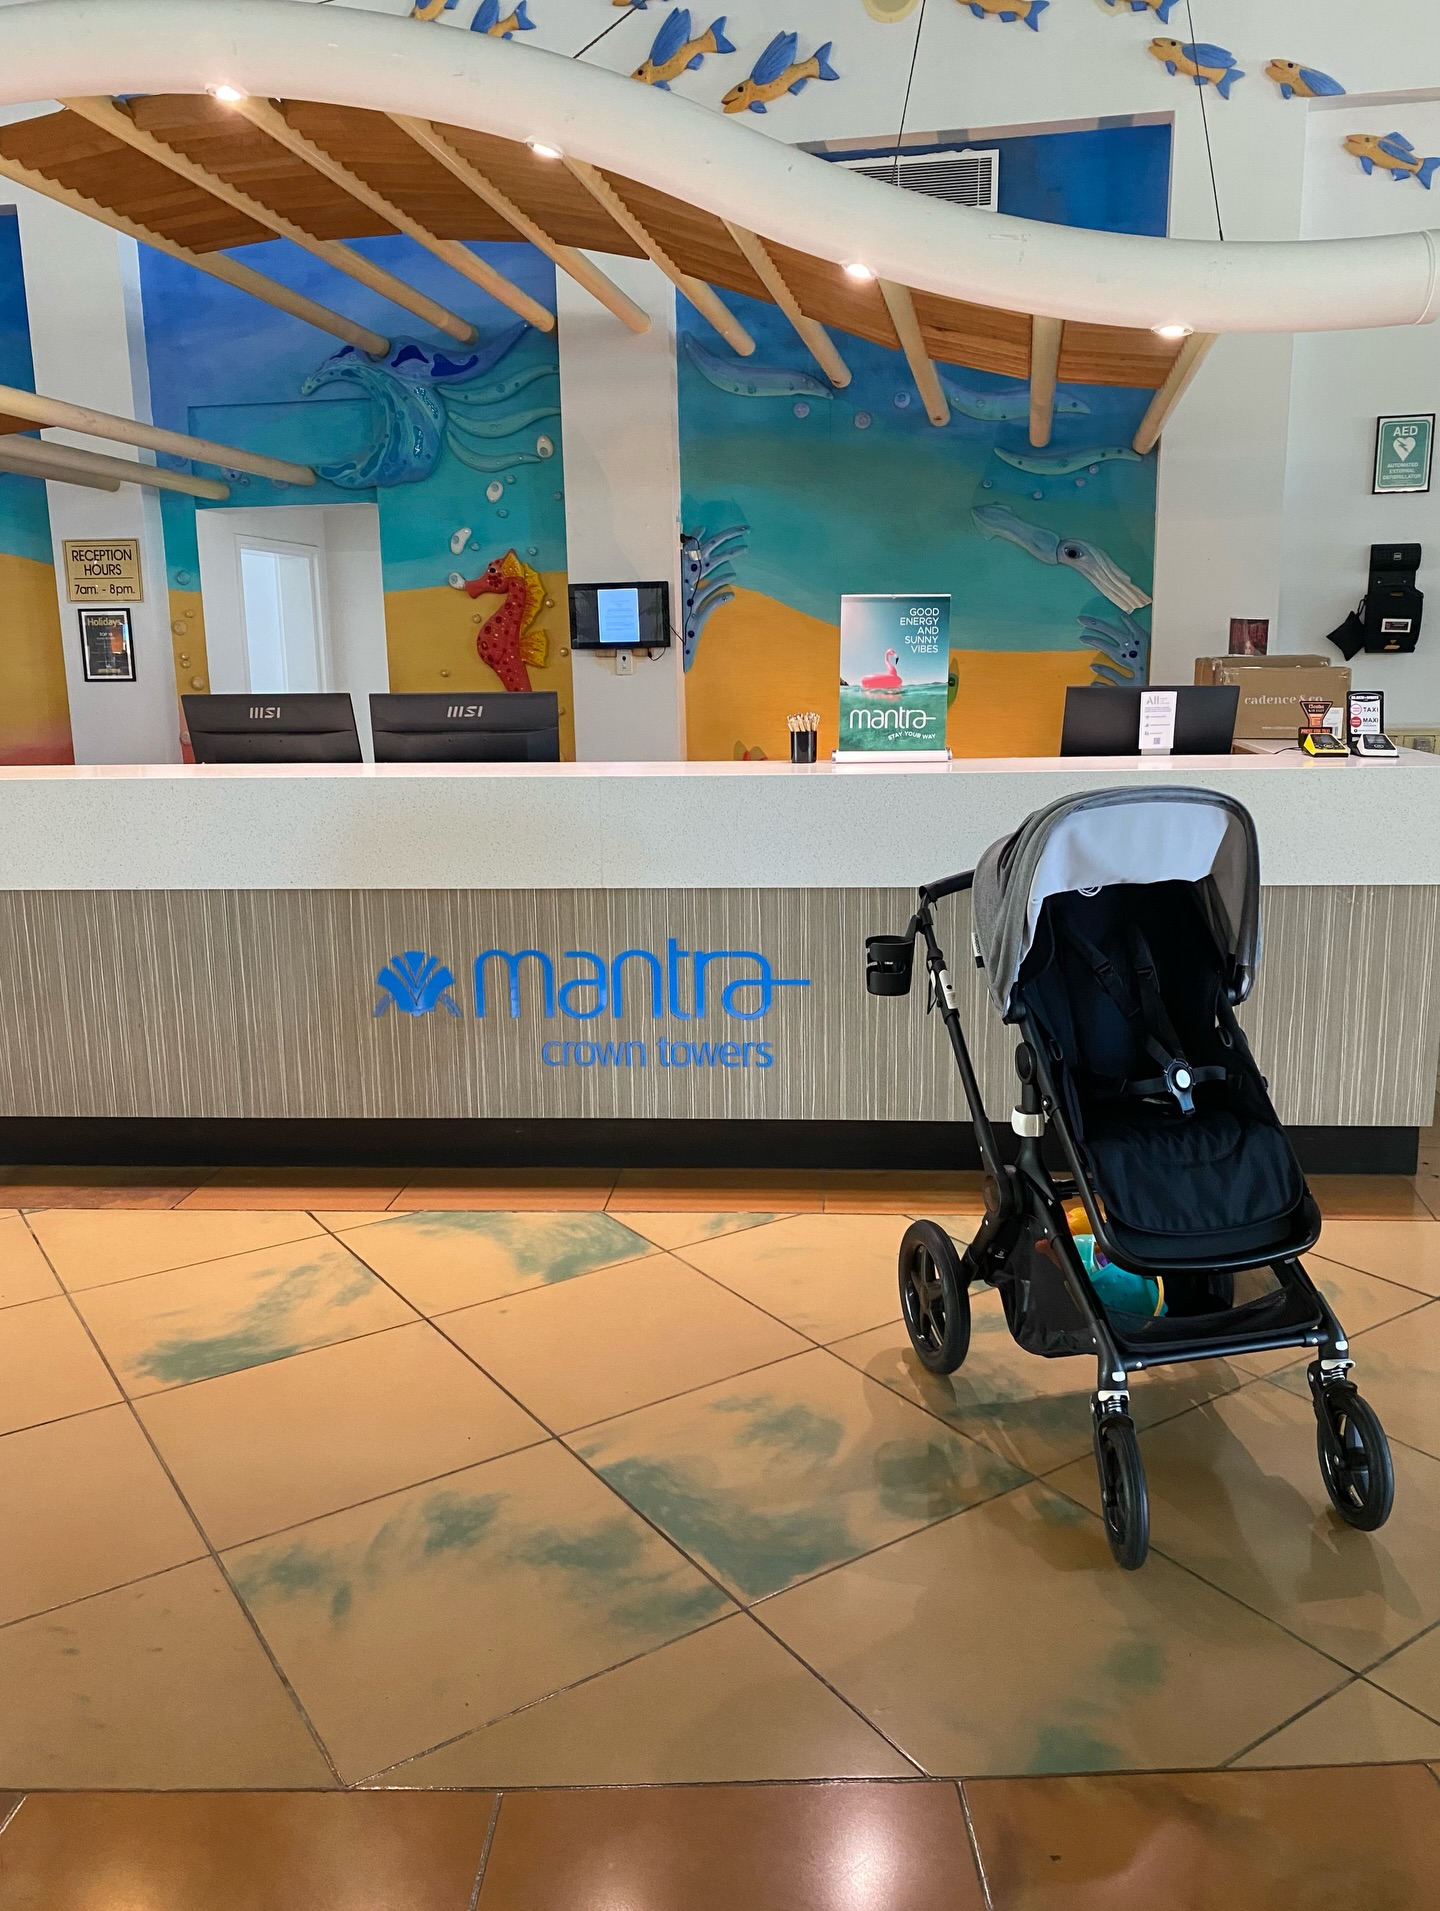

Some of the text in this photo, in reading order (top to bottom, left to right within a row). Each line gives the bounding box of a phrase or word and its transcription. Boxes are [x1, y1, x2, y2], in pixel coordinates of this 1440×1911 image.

[1393, 426, 1418, 436] AED
[71, 549, 132, 561] RECEPTION
[84, 563, 122, 576] HOURS
[909, 607, 940, 617] GOOD
[87, 617, 121, 628] Holidays
[900, 617, 940, 626] ENERGY
[917, 626, 939, 635] AND
[905, 635, 939, 644] SUNNY
[911, 645, 939, 653] VIBES
[1244, 695, 1297, 705] cadence
[849, 706, 937, 729] mantra
[888, 731, 903, 741] STAY
[904, 731, 922, 739] YOUR
[474, 938, 810, 1020] mantra
[542, 1036, 774, 1067] crown towers
